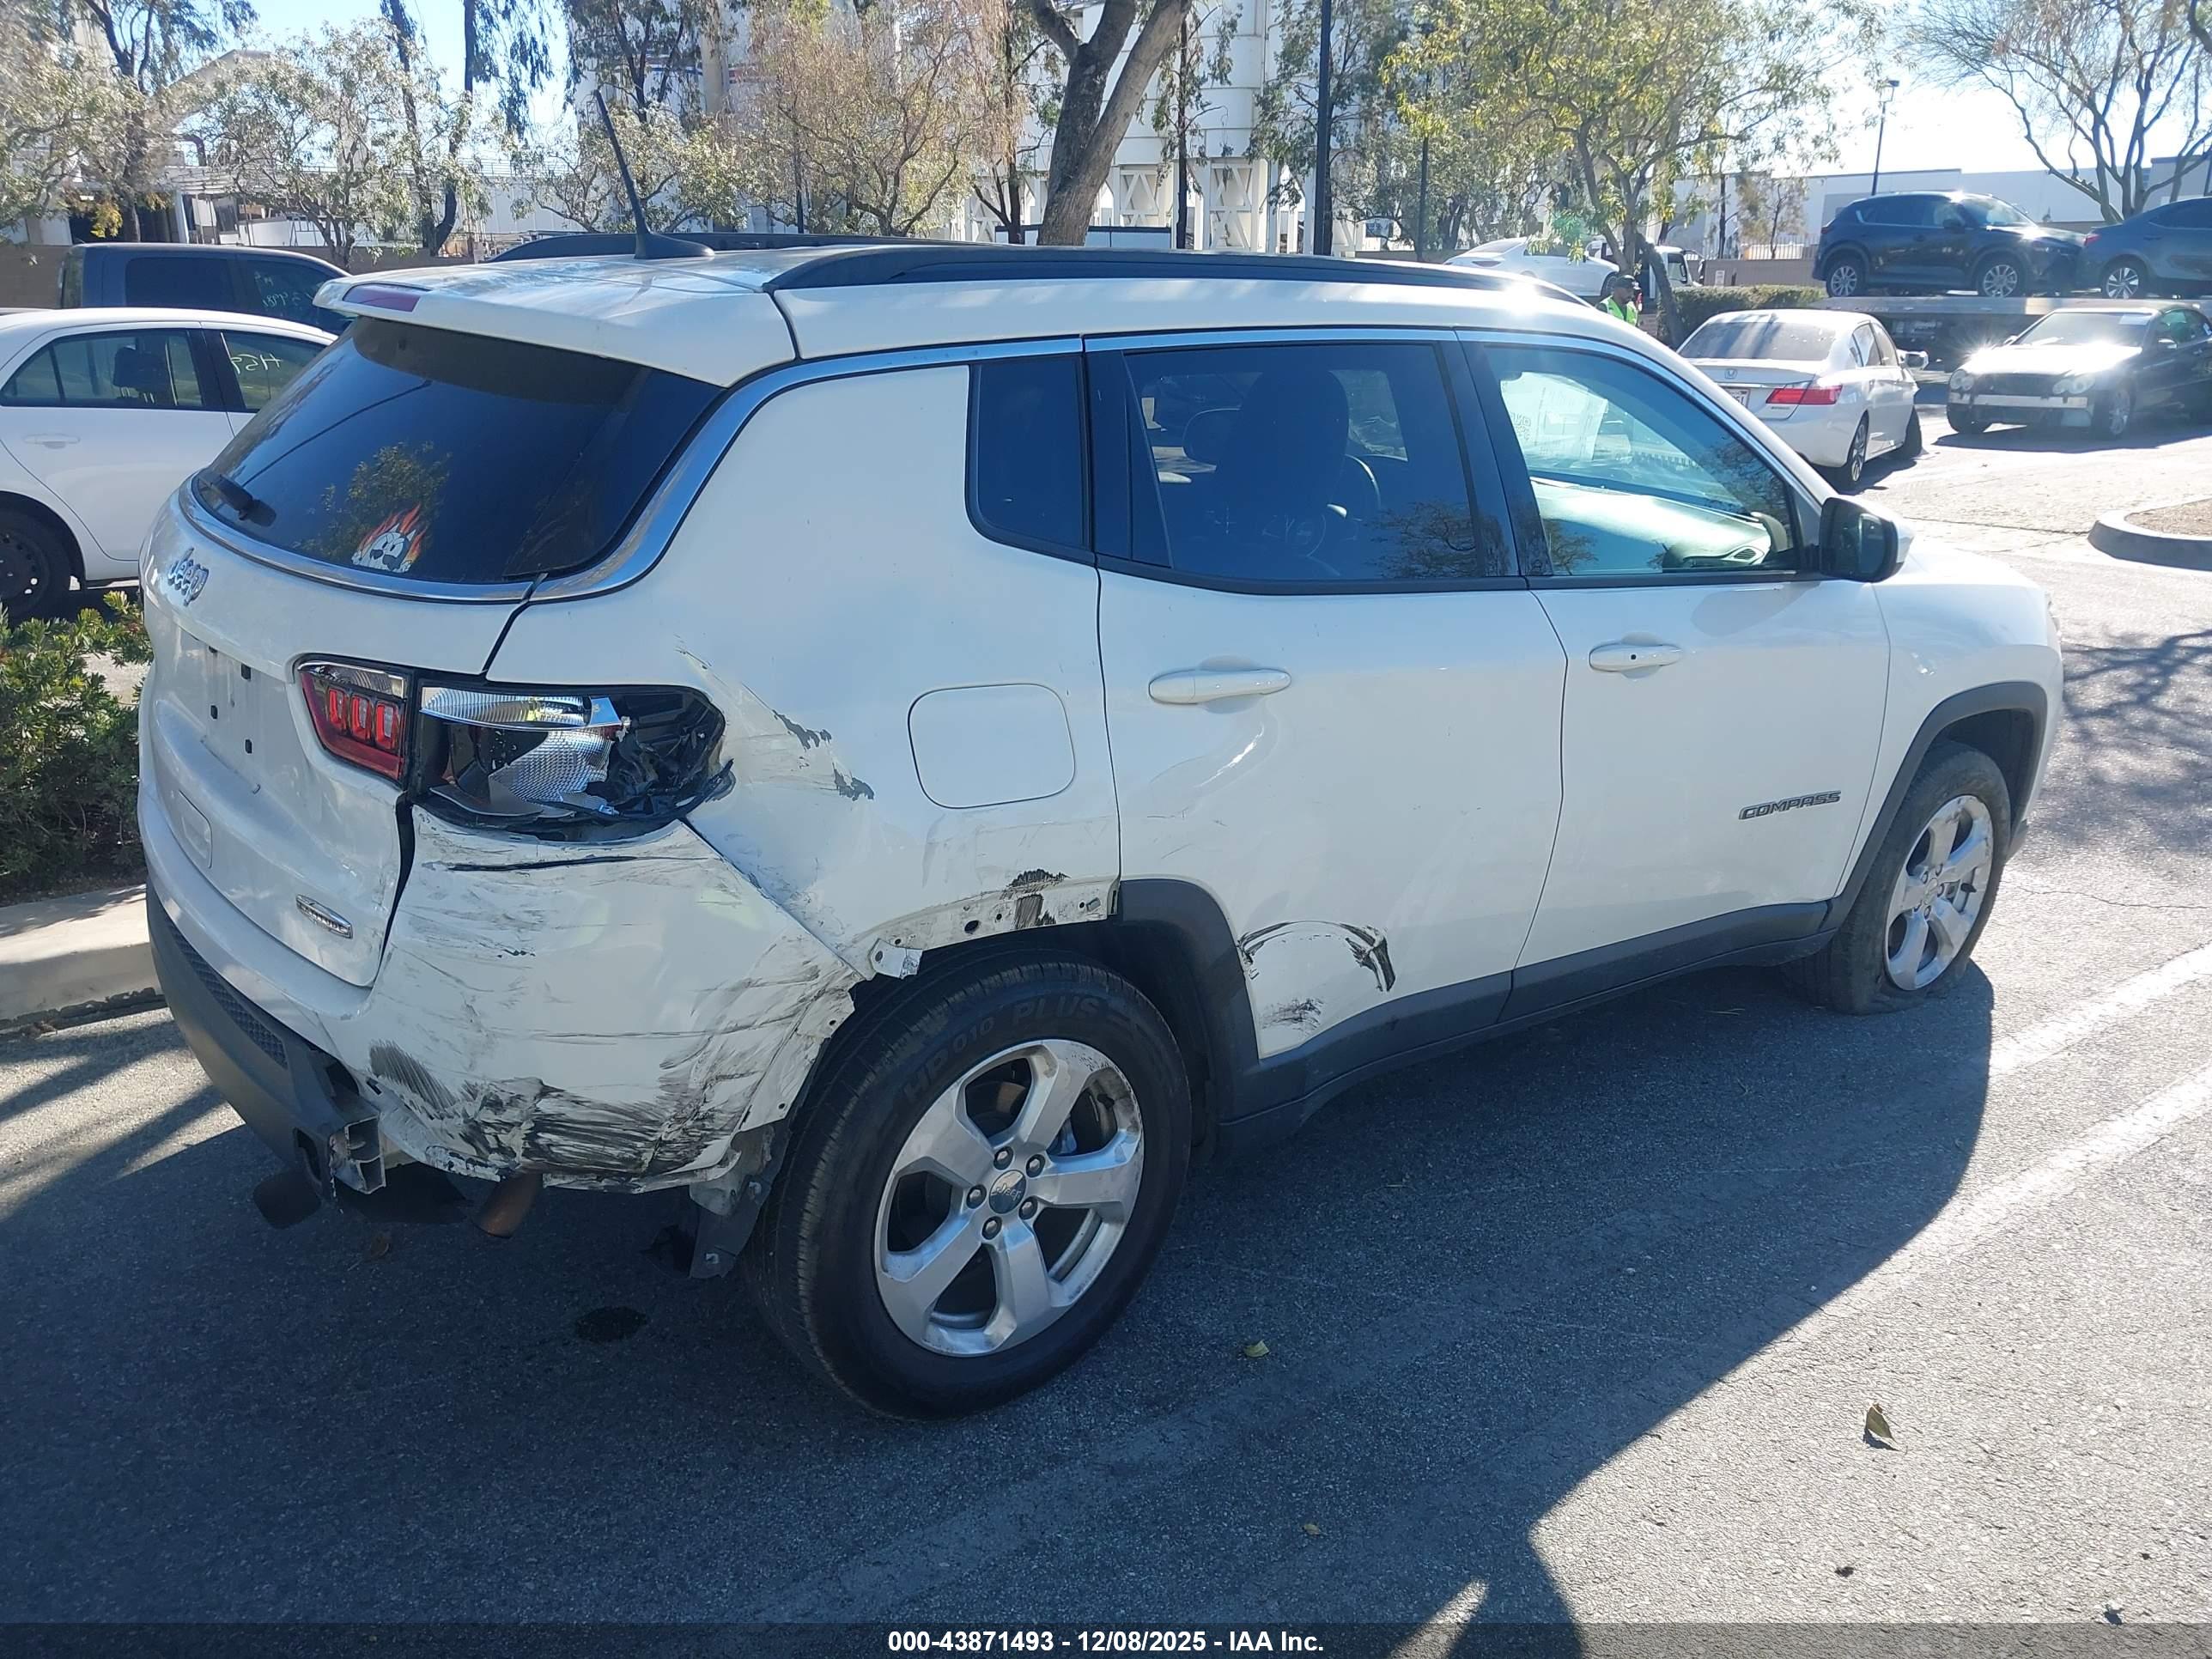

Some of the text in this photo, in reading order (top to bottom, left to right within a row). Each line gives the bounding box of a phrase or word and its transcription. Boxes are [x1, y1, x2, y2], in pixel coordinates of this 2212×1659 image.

[167, 548, 209, 606] Jeep
[1739, 790, 1841, 820] COMPASS
[1011, 995, 1102, 1023] PLUS
[990, 1182, 1022, 1201] Jeep
